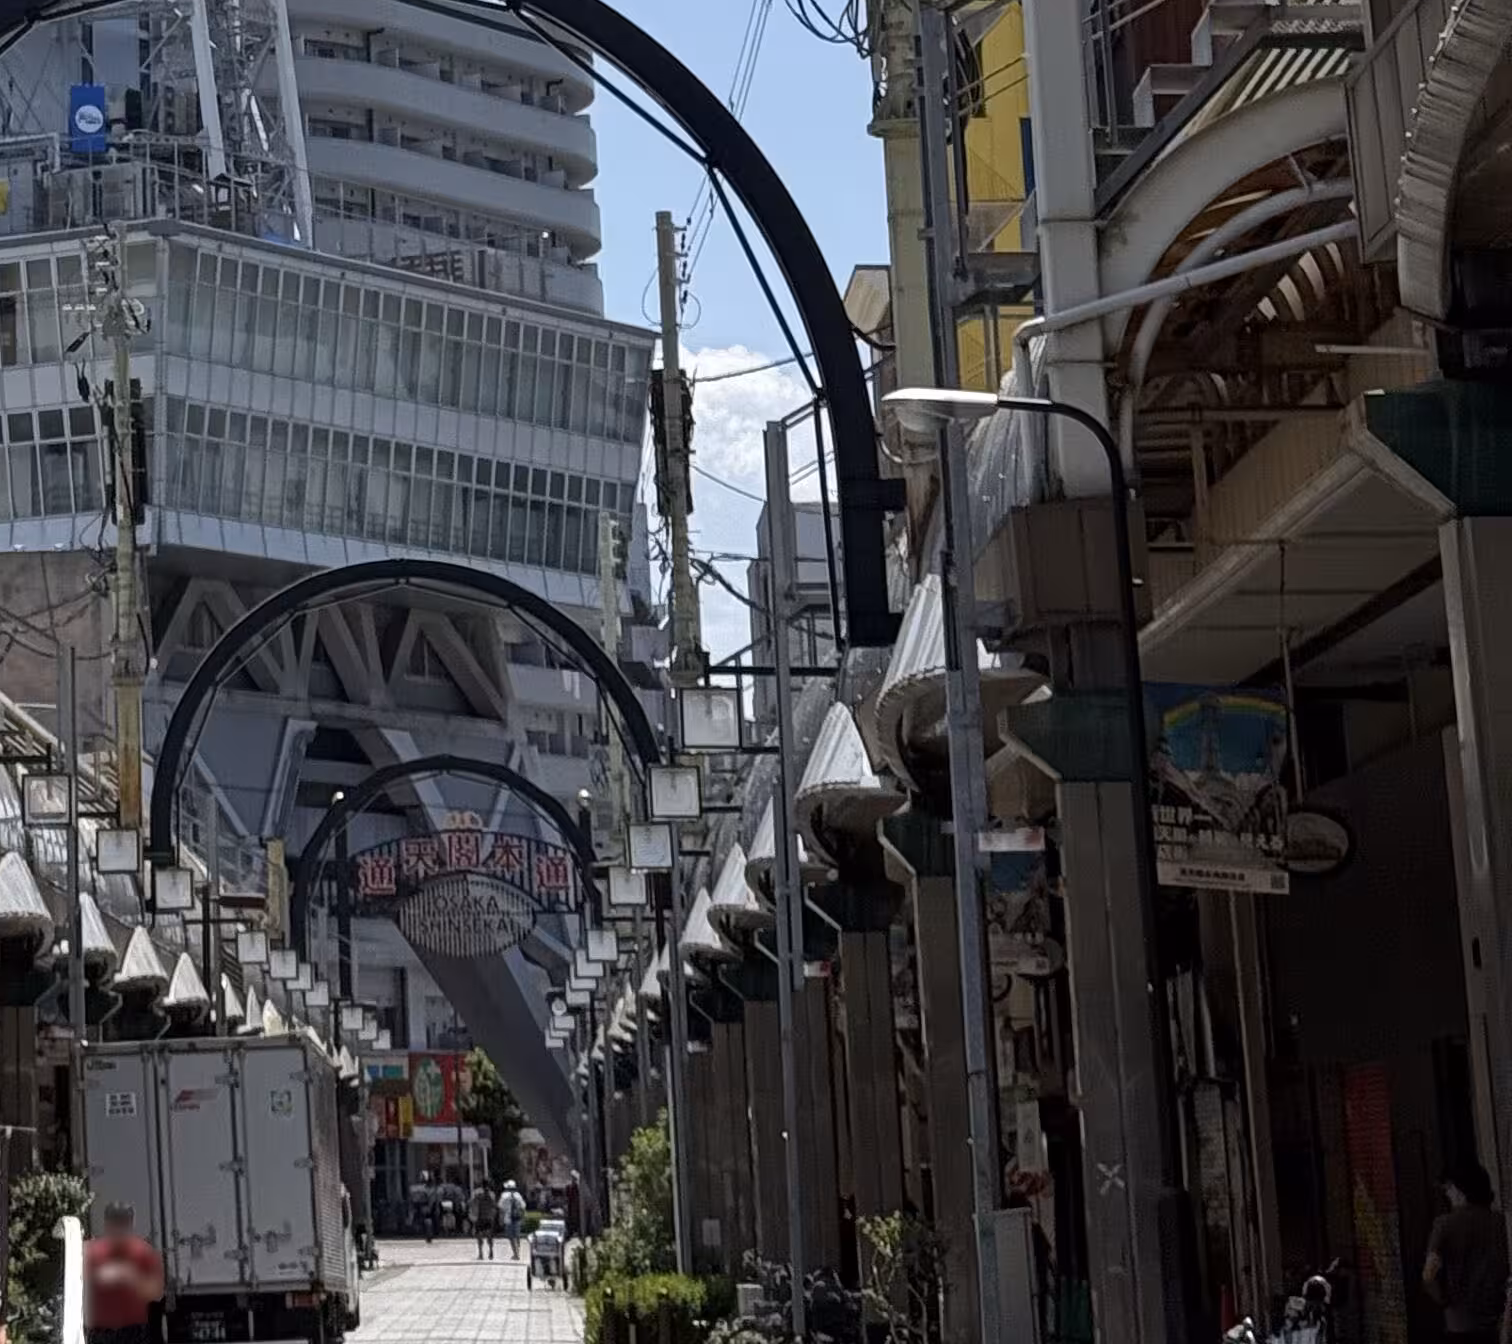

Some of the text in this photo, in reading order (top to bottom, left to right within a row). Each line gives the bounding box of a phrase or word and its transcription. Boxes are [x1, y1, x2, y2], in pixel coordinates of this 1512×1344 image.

[357, 831, 569, 896] 通天閣本通
[434, 895, 499, 912] OSAKA
[419, 917, 514, 934] SHINSEKAI
